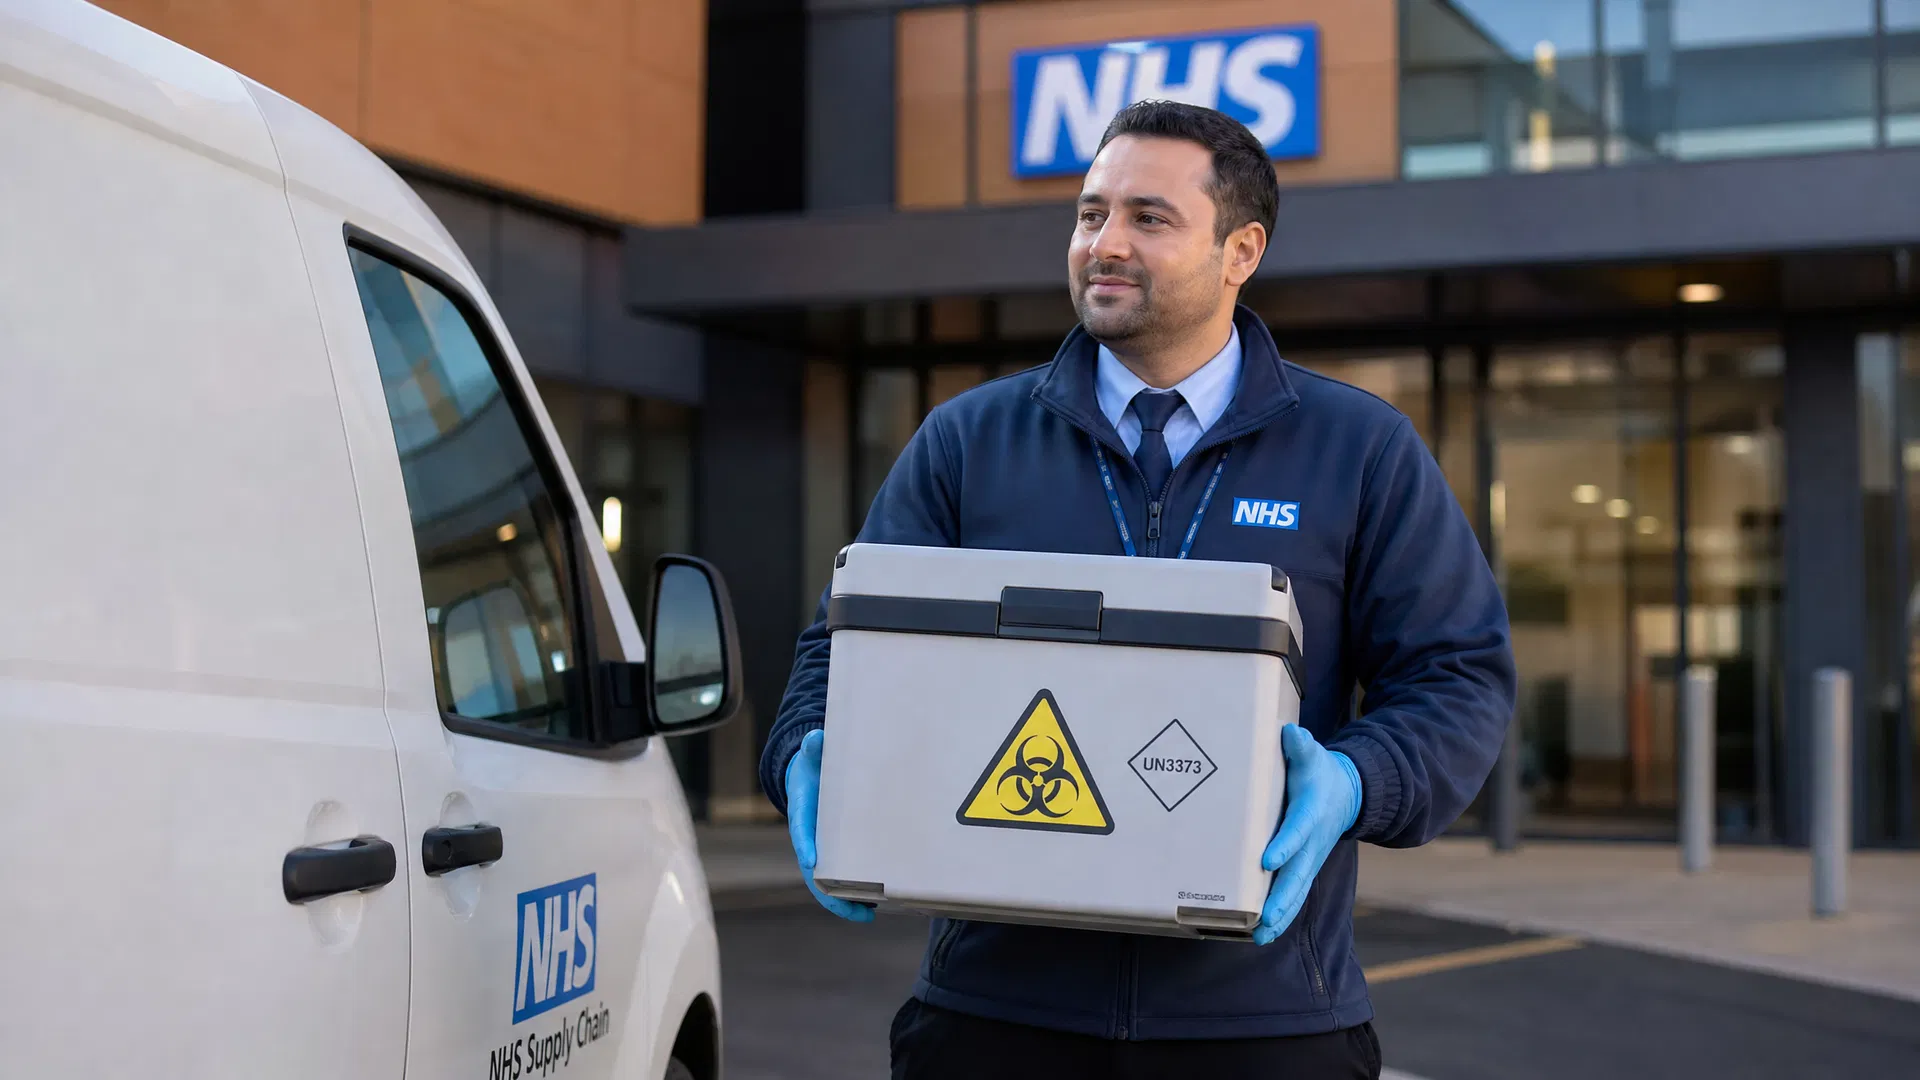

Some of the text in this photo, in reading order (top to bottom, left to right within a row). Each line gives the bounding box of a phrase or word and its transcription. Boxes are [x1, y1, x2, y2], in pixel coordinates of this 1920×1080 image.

[1021, 34, 1304, 166] NHS
[1234, 500, 1298, 527] NHS
[1143, 757, 1202, 774] UN3373
[515, 883, 595, 1012] NHS
[489, 1001, 610, 1080] NHS Supply Chain
